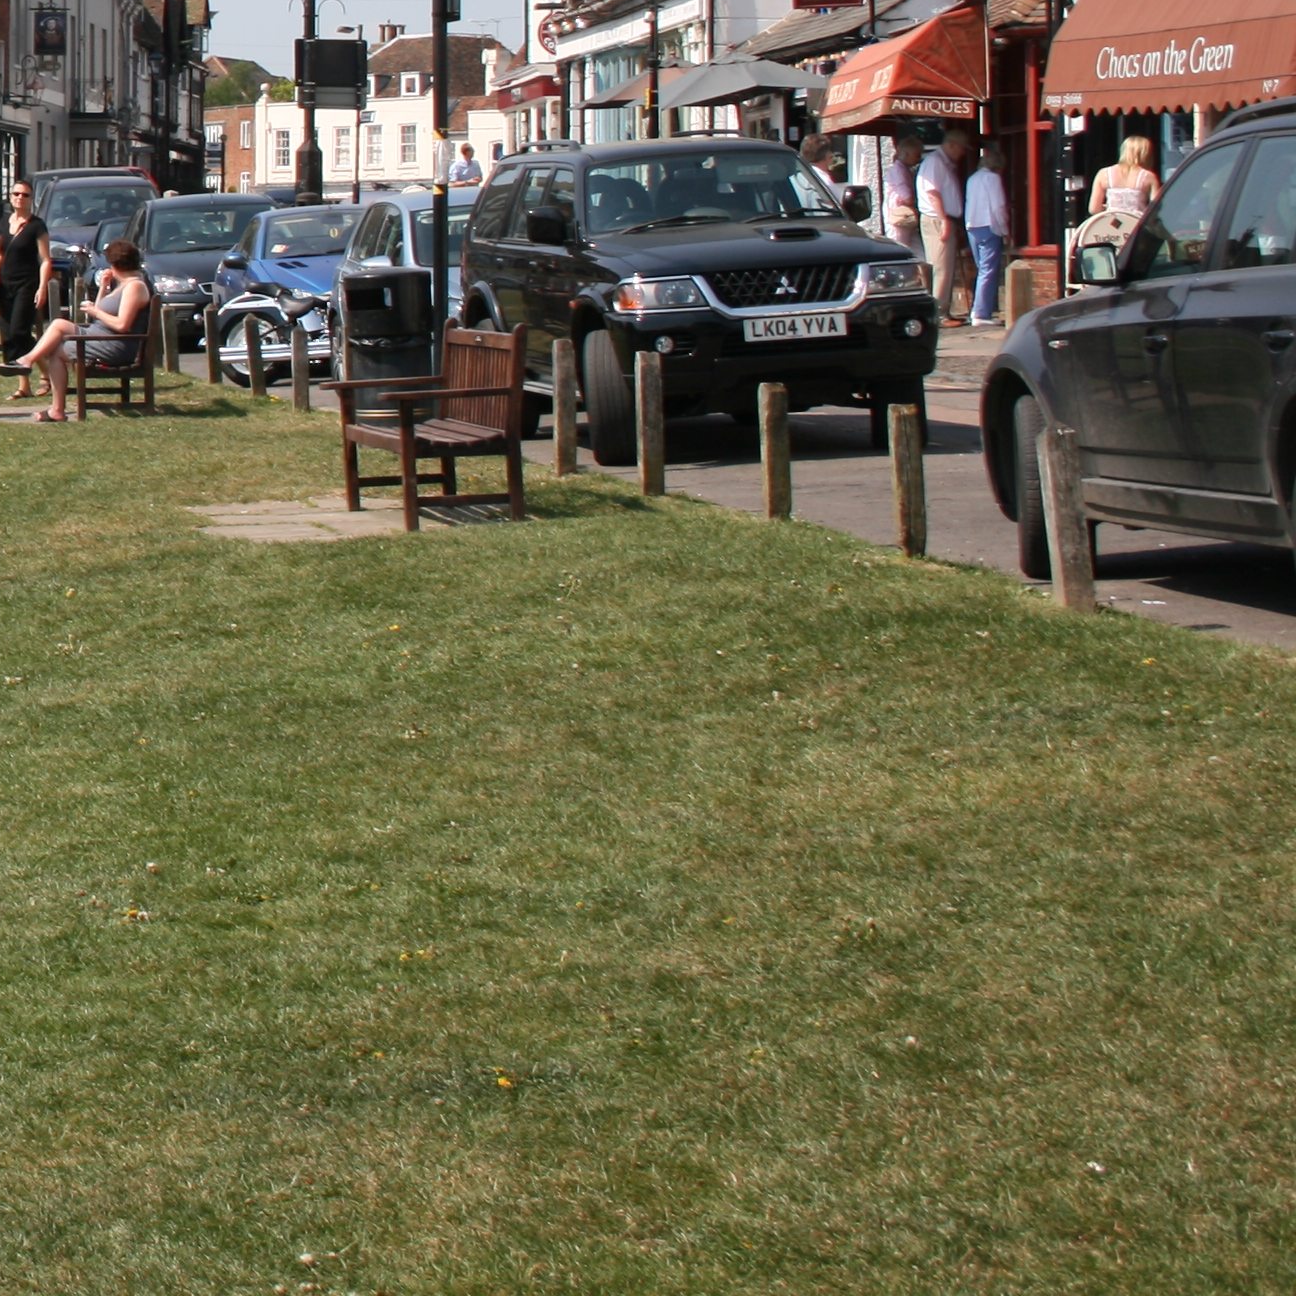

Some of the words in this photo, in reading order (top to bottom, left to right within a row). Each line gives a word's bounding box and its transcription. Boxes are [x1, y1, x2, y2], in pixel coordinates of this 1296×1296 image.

[1096, 46, 1140, 79] Chocs
[1142, 51, 1160, 77] on
[1163, 39, 1187, 76] the
[1189, 36, 1234, 74] Green
[891, 98, 971, 115] ANTIQUES
[1093, 234, 1120, 243] Tudor
[751, 319, 799, 338] LK04
[802, 316, 838, 335] YVA
